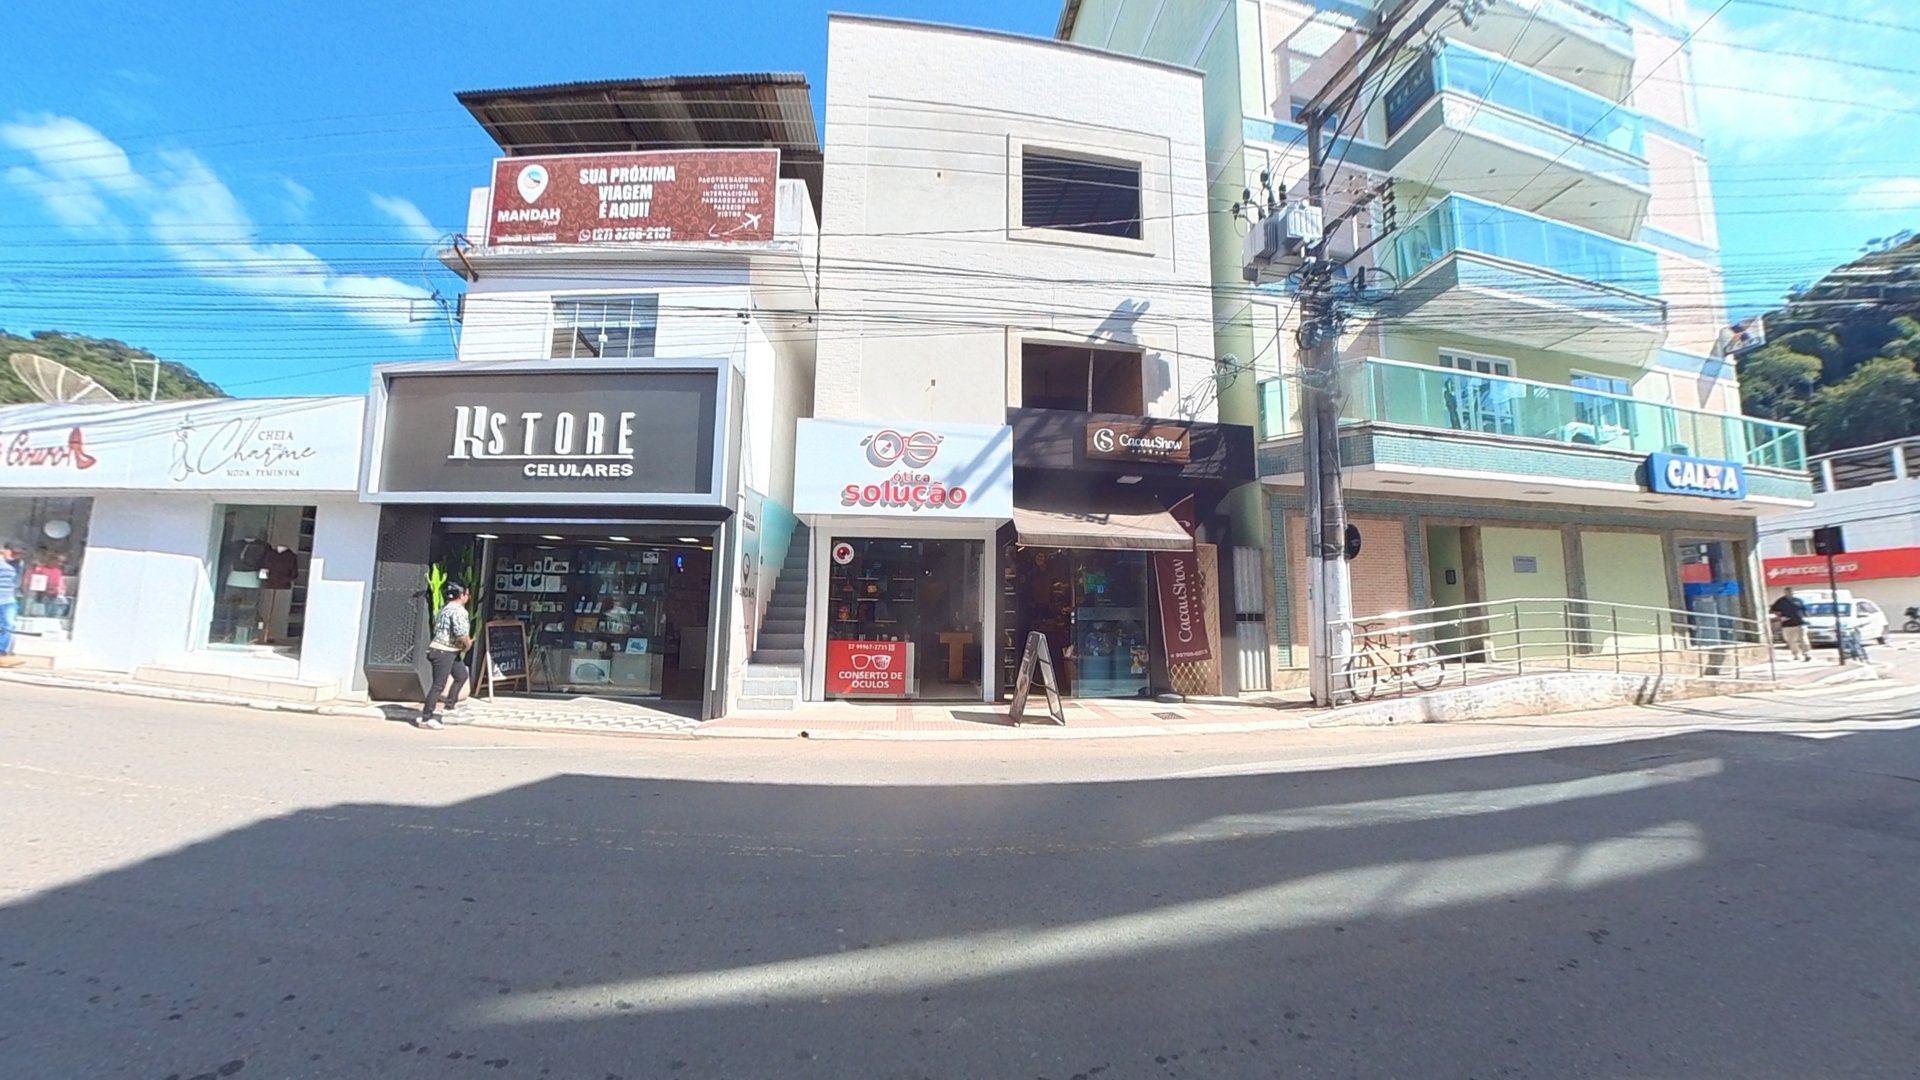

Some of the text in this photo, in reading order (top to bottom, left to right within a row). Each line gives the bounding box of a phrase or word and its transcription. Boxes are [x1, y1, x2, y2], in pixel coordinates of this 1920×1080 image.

[579, 165, 676, 184] SUA PRÓXIMA
[598, 184, 653, 201] VIAGEM
[497, 208, 561, 223] MANDAH
[599, 201, 650, 219] É AQUI!
[592, 228, 614, 241] (27)
[257, 430, 294, 441] CHEIA
[197, 417, 316, 475] Charme
[226, 469, 300, 477] MODA FEMININA
[523, 463, 634, 477] CELULARES
[893, 471, 931, 483] ótica
[1666, 458, 1741, 493] CAIXA
[845, 480, 967, 507] solução
[838, 670, 903, 680] CONSERTO DE
